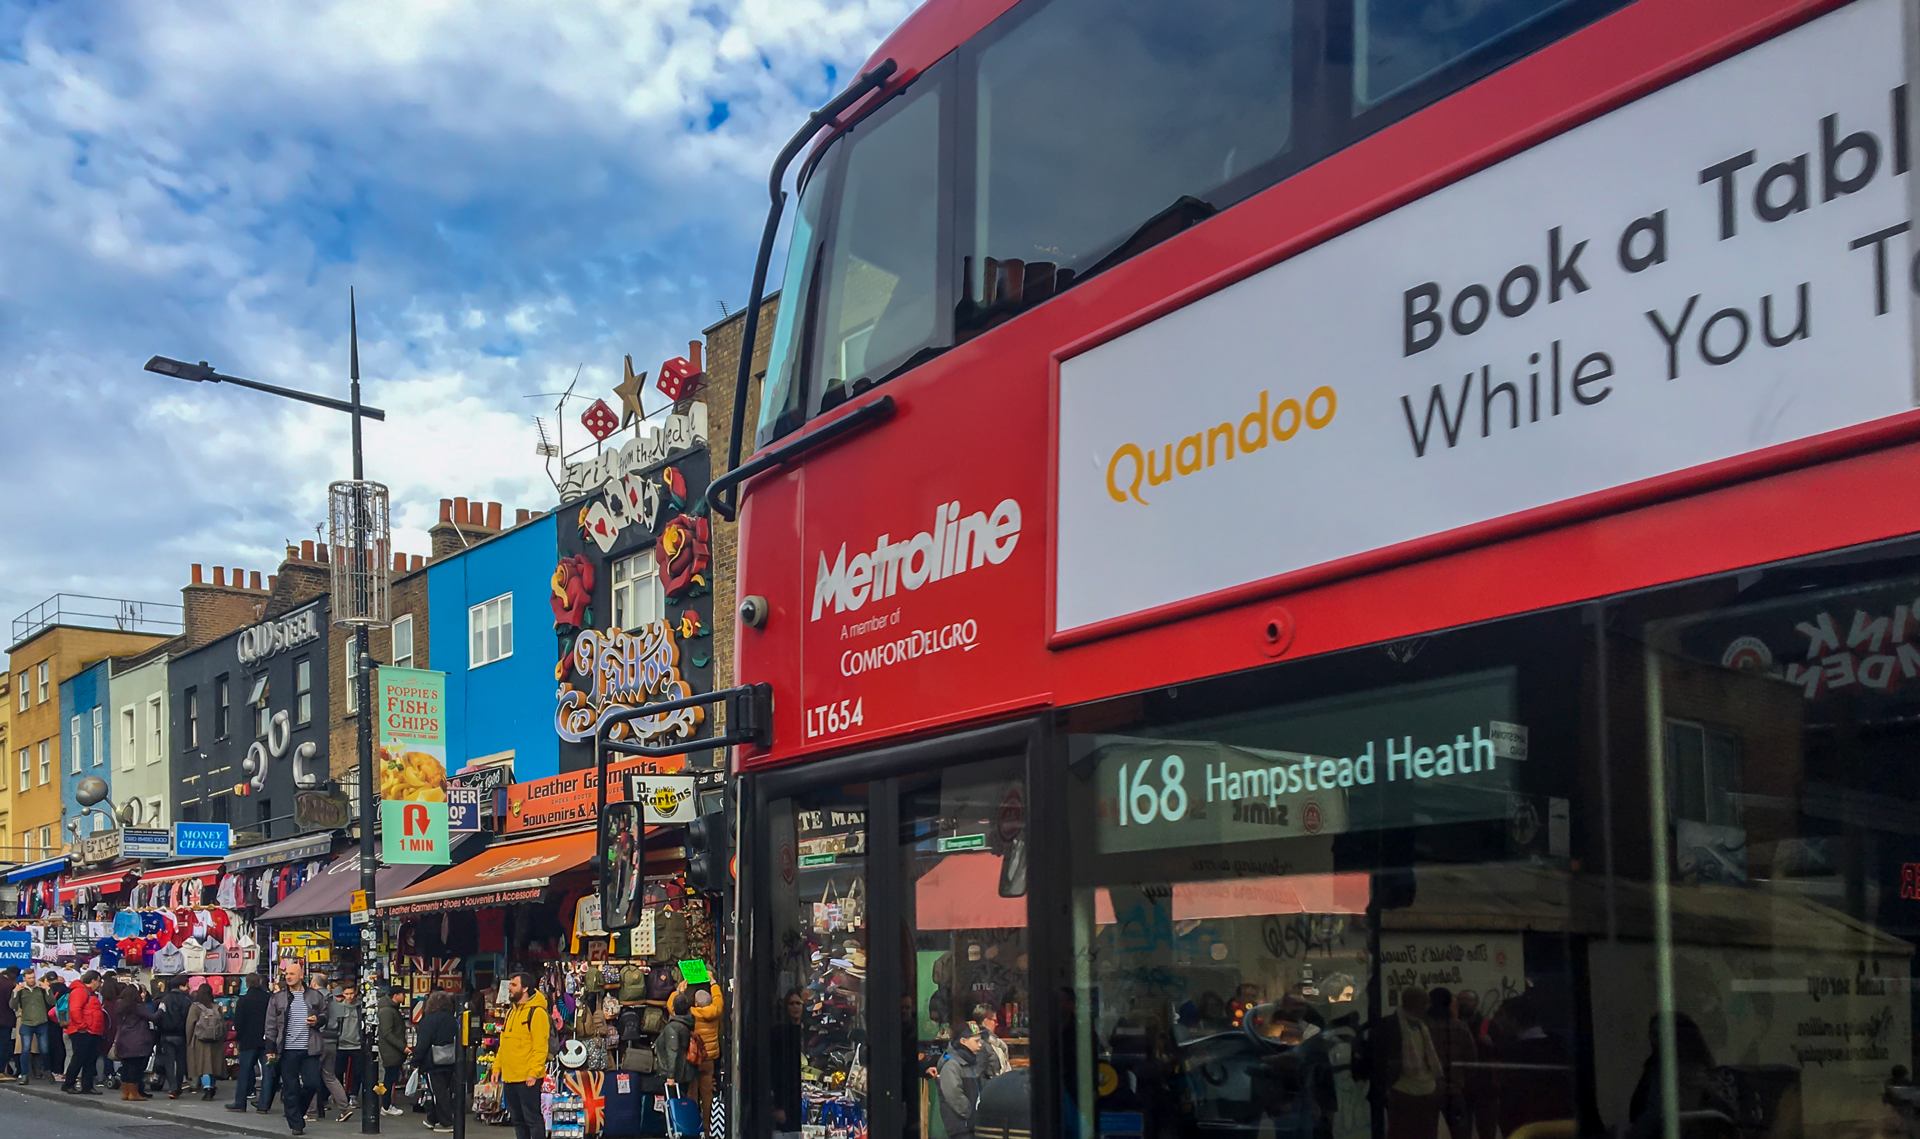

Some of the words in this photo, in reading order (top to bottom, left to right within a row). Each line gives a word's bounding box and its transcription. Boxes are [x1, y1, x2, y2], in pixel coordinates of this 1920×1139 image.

[1402, 225, 1590, 358] Book
[1617, 208, 1669, 274] a
[1401, 339, 1614, 458] While
[1645, 282, 1811, 381] You
[1849, 219, 1920, 317] T
[1105, 384, 1338, 506] Quandoo
[810, 498, 1022, 622] Metroline
[840, 624, 849, 640] A
[850, 615, 889, 635] member
[892, 606, 901, 626] of
[386, 685, 438, 700] POPPIE'S
[387, 697, 428, 715] FISH
[807, 696, 863, 738] LT654
[387, 713, 439, 732] CHIPS
[1118, 754, 1188, 826] 168
[1207, 741, 1375, 808] Hampstead
[1387, 726, 1496, 781] Heath
[528, 778, 578, 800] Leather
[637, 787, 692, 807] Martens
[523, 807, 576, 827] Souvenirs
[577, 803, 586, 818] &
[179, 840, 226, 849] CHANGE
[182, 830, 223, 840] MONEY
[399, 840, 405, 850] 1
[410, 839, 434, 852] MIN
[389, 904, 410, 916] Leather
[411, 901, 439, 913] Garments
[443, 899, 461, 909] Shoes
[464, 895, 494, 907] Souvenirs
[495, 894, 500, 902] &
[502, 888, 541, 901] Accessories
